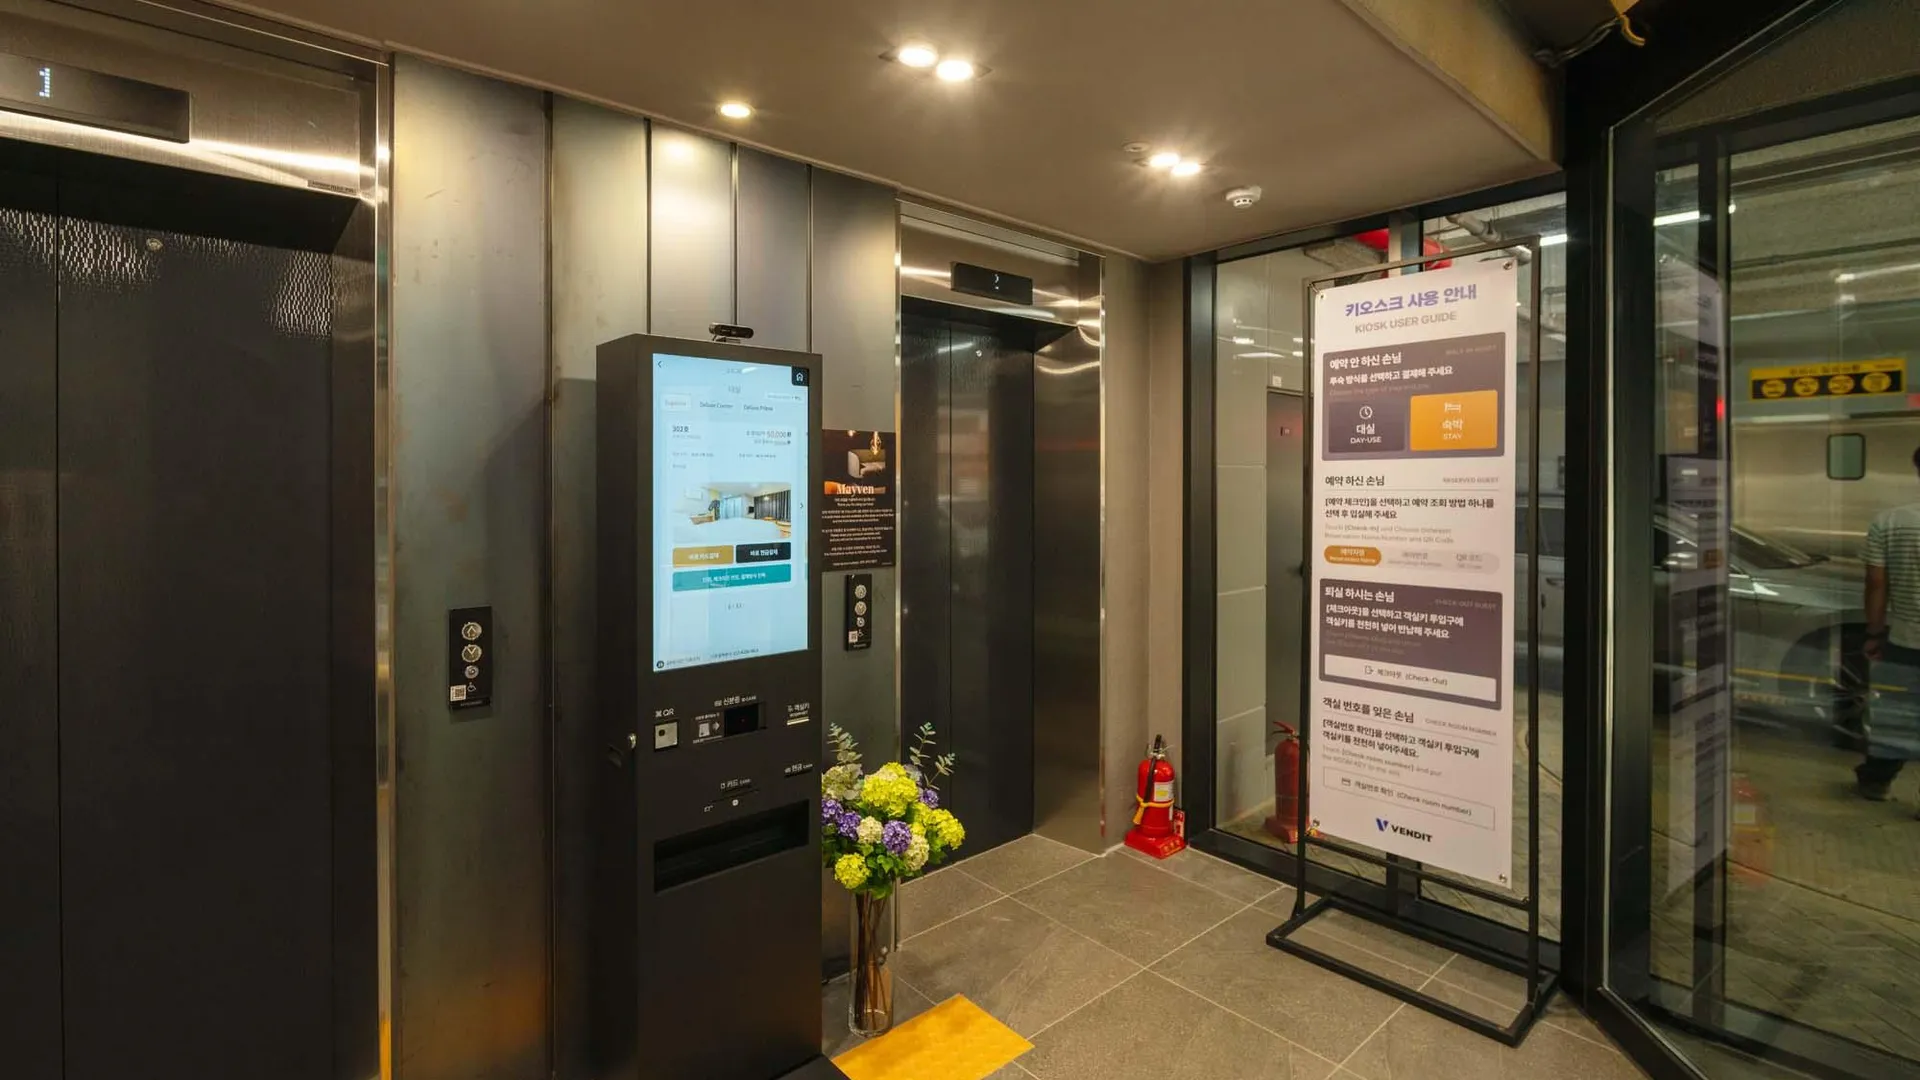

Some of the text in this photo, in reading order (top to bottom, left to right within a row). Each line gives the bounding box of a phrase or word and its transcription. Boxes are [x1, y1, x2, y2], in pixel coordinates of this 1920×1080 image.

[1345, 284, 1477, 317] 키오스크 사용 안내
[1354, 311, 1457, 334] KIOSK USER GUIDE
[1329, 352, 1402, 370] 예약 안 하신 손님
[1345, 373, 1368, 385] 방식을
[1369, 371, 1400, 382] 선택하고
[1427, 365, 1453, 377] 주세요
[1356, 423, 1375, 435] 대실
[1350, 436, 1381, 444] DAY-USE
[1325, 475, 1385, 487] 예약 하신 손님
[1325, 497, 1494, 509] [예약 체크인]을 선택하고 예약 조회 방법 하나를
[1325, 509, 1397, 519] 선택 후 입실해 주세요
[1325, 586, 1395, 603] 퇴실 하시는 손님
[1326, 604, 1464, 627] [체크아웃]을 선택하고 객실키 투입구에
[1325, 616, 1355, 628] 객실키를
[1356, 619, 1380, 631] 천천히
[1398, 625, 1422, 636] 반납해
[1424, 628, 1450, 639] 주세요
[663, 708, 675, 716] QR
[1322, 697, 1414, 723] 객실 번호를 잊은 손님
[1322, 730, 1351, 743] 객실키를
[1353, 736, 1376, 749] 천천히
[1323, 718, 1480, 759] [객실번호 확인]을 선택하고 객실키 투입구에
[1391, 824, 1433, 843] VENDIT
